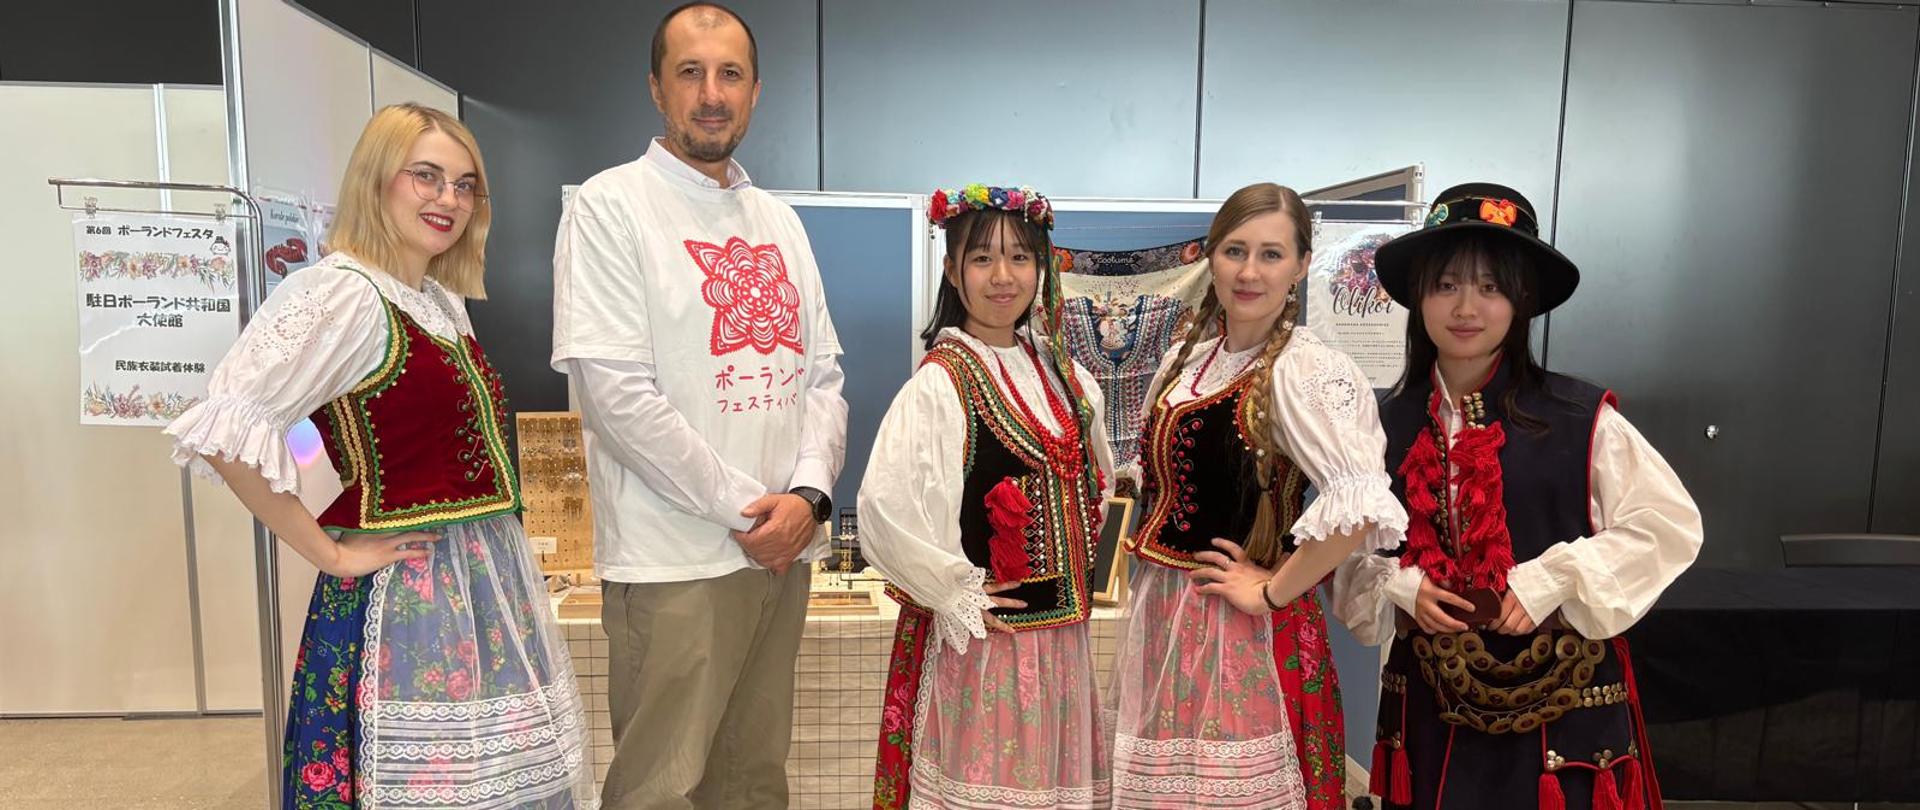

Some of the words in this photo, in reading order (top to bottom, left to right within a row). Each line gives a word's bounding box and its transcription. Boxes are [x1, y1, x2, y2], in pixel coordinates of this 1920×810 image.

[86, 225, 112, 235] 第6回
[117, 224, 214, 240] ポーランドフェスタ
[86, 293, 231, 312] 駐日ポーランド共和国
[136, 312, 184, 328] 大使館
[115, 360, 205, 373] 民族衣装試着体験
[717, 393, 798, 413] フェスティバ
